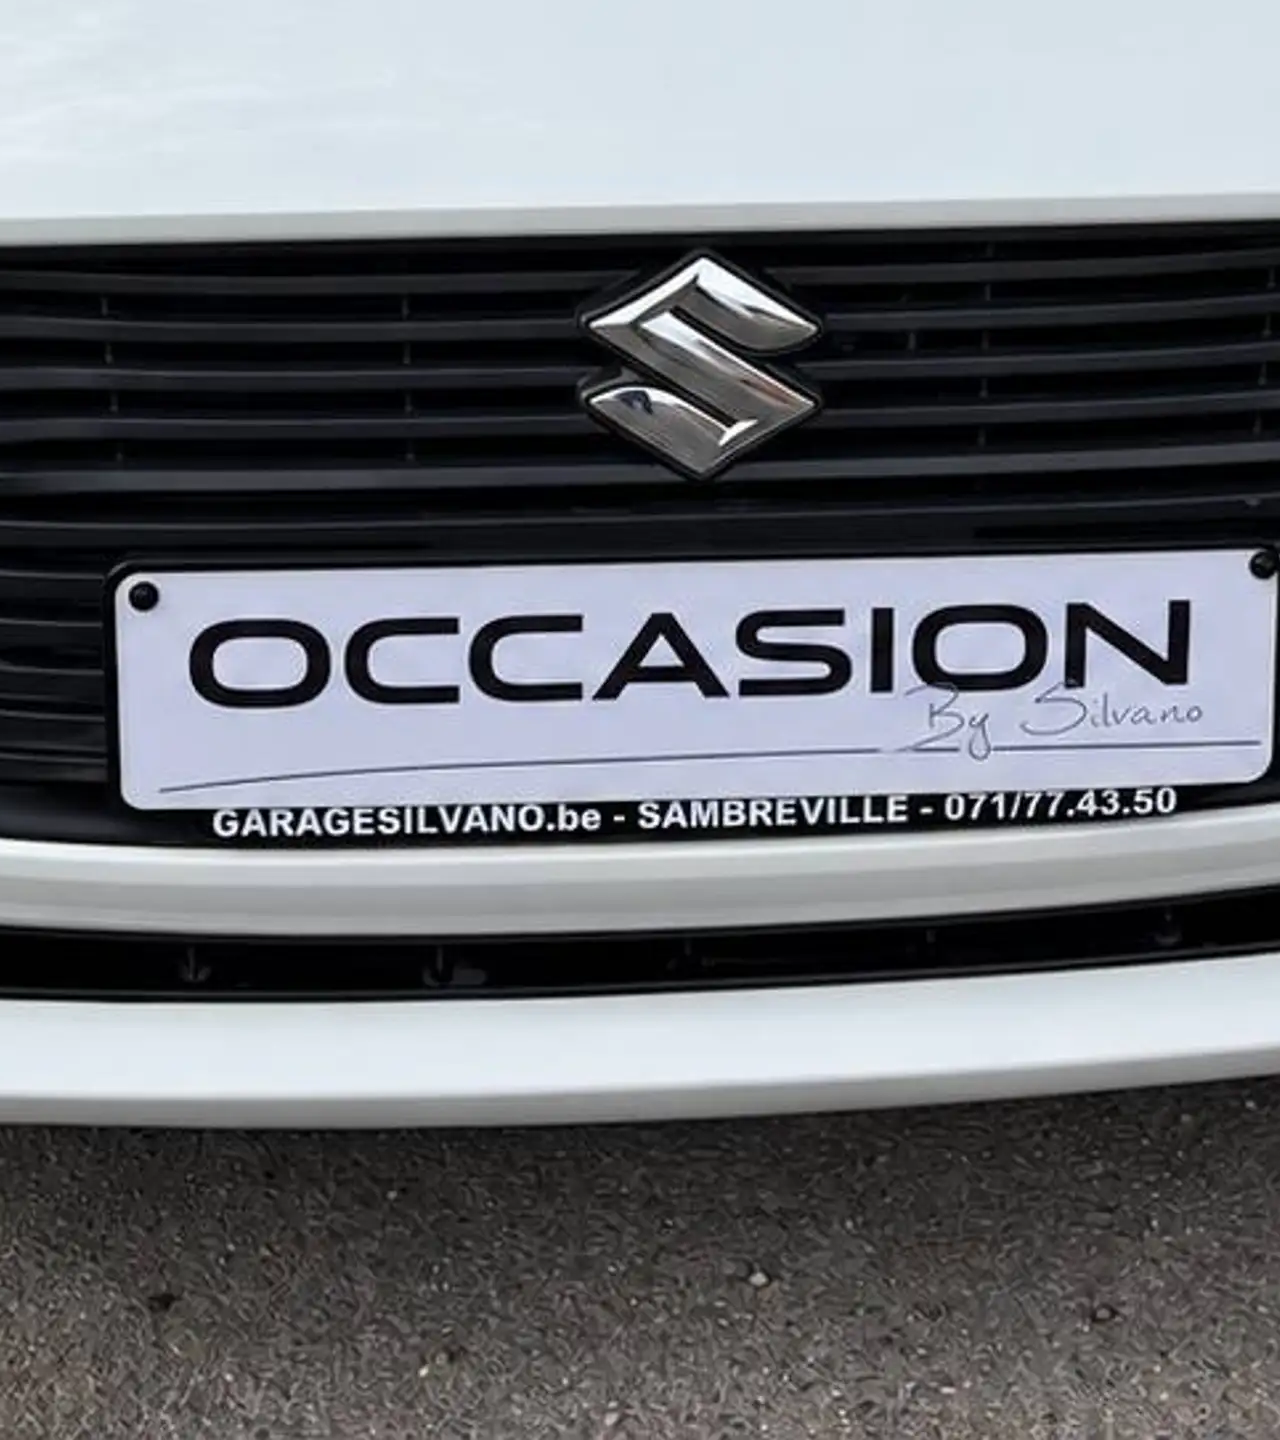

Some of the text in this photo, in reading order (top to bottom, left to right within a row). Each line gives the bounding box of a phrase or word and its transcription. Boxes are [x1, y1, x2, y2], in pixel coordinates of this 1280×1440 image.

[188, 599, 1191, 709] OCCASION
[896, 679, 1204, 761] By Silvano
[212, 802, 602, 838] GARAGESILVANO.be
[637, 795, 909, 830] SAMBREVILLE
[944, 786, 1178, 823] 071/77.43.50
